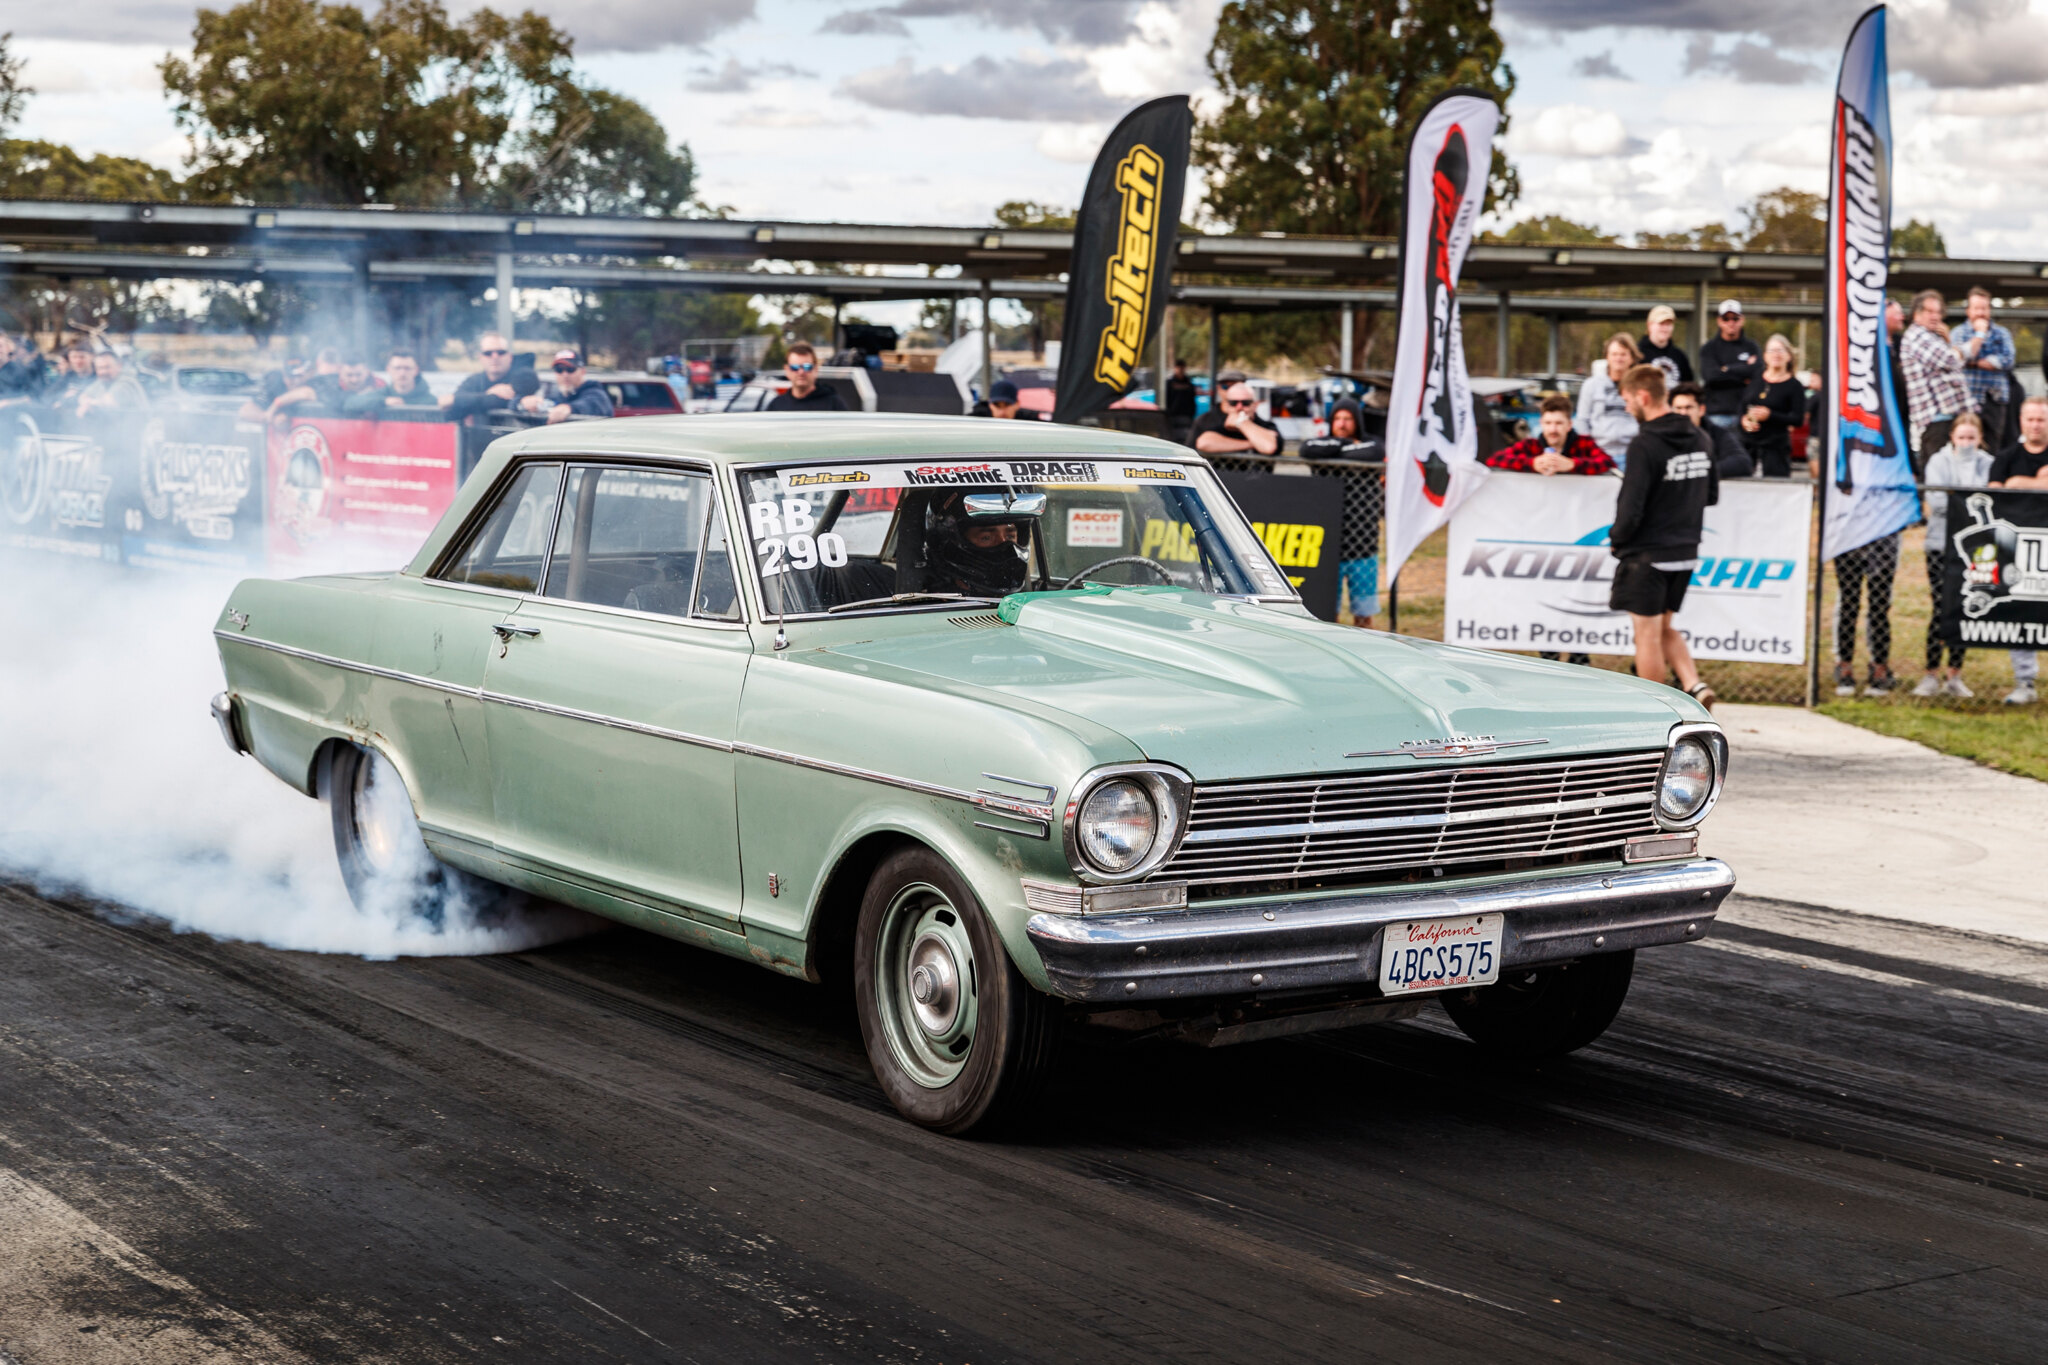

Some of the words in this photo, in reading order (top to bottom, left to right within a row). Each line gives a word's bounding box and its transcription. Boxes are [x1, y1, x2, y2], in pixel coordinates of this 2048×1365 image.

[1095, 145, 1163, 391] Haltech
[789, 471, 870, 487] Haltech
[904, 469, 1007, 485] MACHINE
[918, 463, 991, 475] Street
[1007, 462, 1083, 476] DRAG
[1014, 475, 1086, 483] CHALLENGE
[1122, 467, 1186, 480] Haltech
[749, 498, 814, 540] RB
[1072, 513, 1119, 522] ASCOT
[1140, 519, 1325, 568] PACKER
[758, 533, 848, 578] 290
[1462, 546, 1797, 589] KOOLRAP
[1457, 620, 1519, 641] Heat
[1530, 624, 1637, 647] Protecti
[1409, 922, 1481, 944] California
[1389, 941, 1492, 984] 4BCS575
